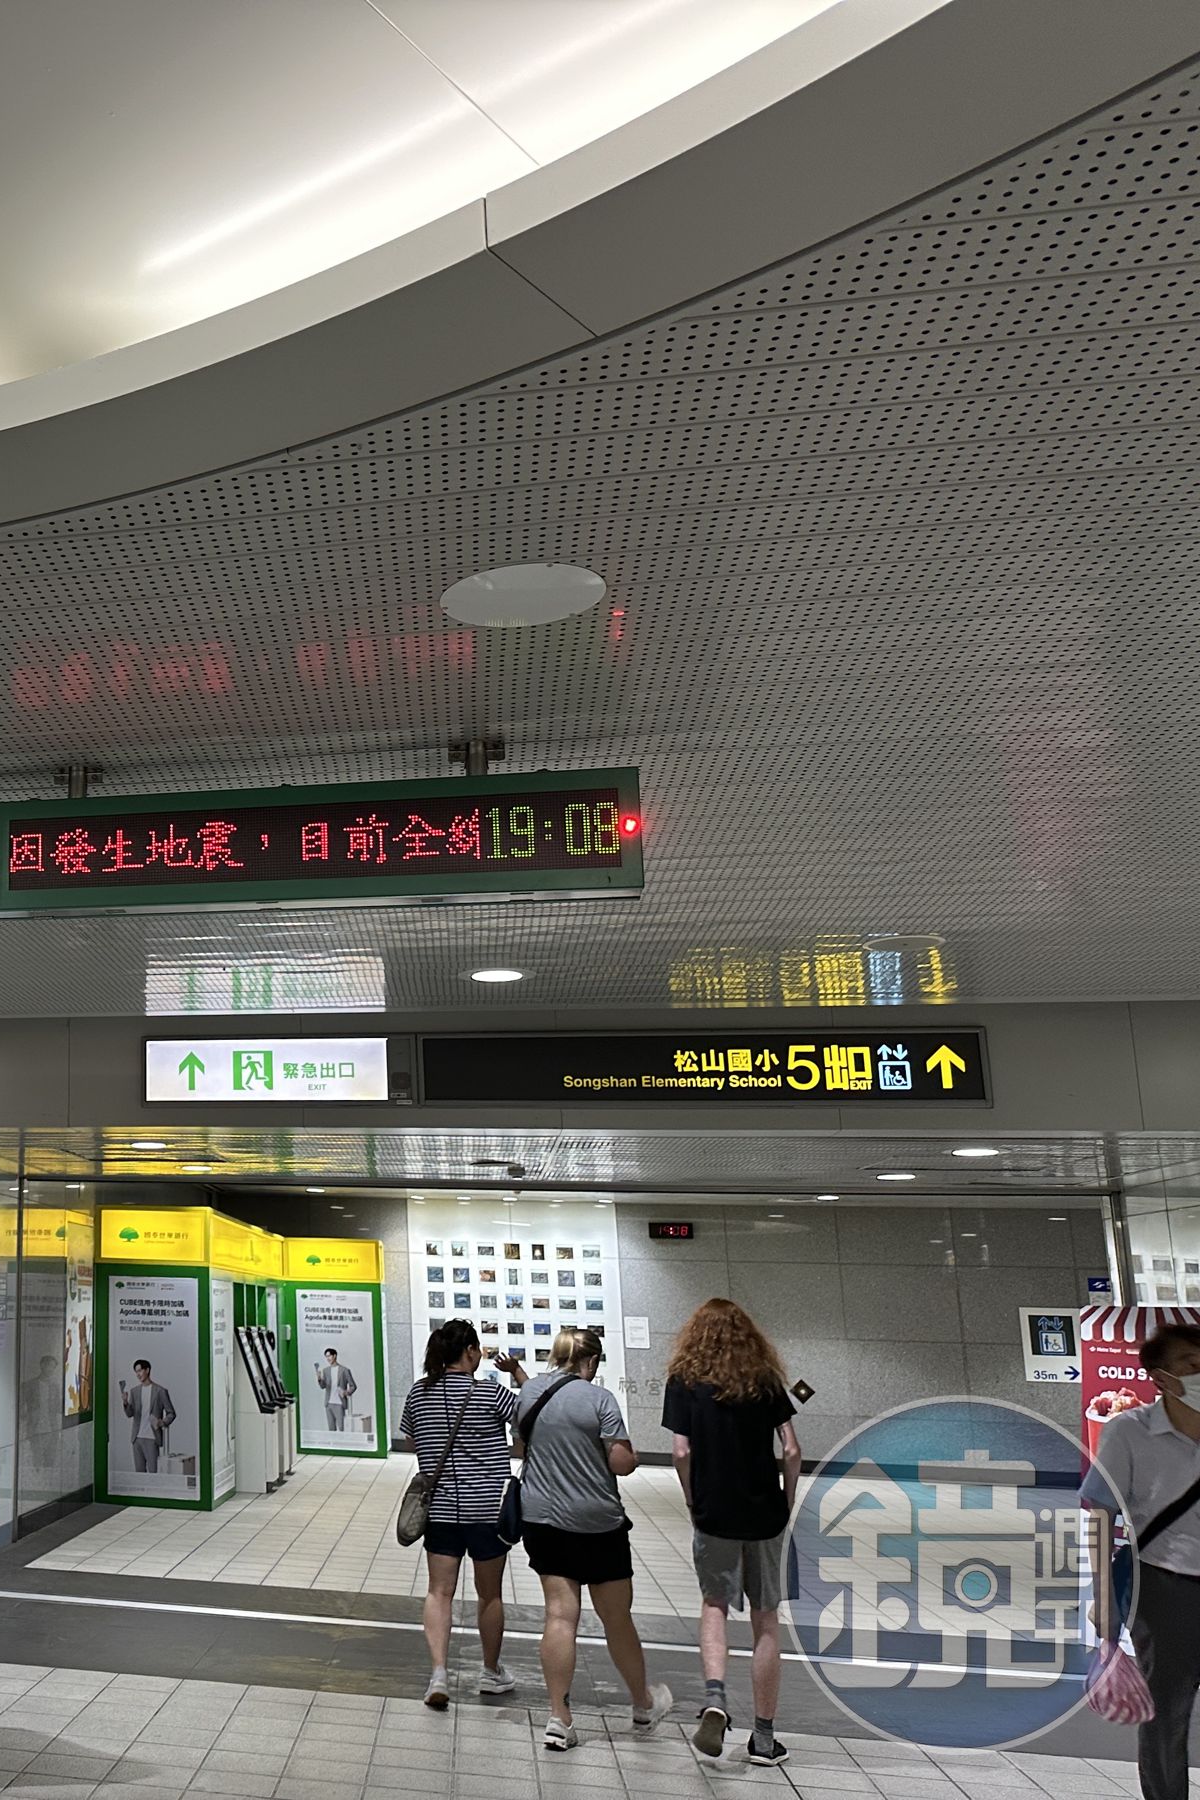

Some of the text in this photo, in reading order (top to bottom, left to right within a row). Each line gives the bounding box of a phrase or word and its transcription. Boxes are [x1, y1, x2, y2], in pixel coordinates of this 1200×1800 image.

[485, 802, 621, 859] 19:08
[674, 1049, 780, 1072] 松山國小
[786, 1045, 820, 1090] 5
[823, 1045, 873, 1090] 出口
[283, 1062, 355, 1079] 緊急出口
[307, 1083, 327, 1091] EXIT
[563, 1074, 782, 1090] Songshan Elementary School
[849, 1080, 873, 1090] EXIT
[1033, 1370, 1058, 1380] 35m
[1098, 1366, 1135, 1380] COLD
